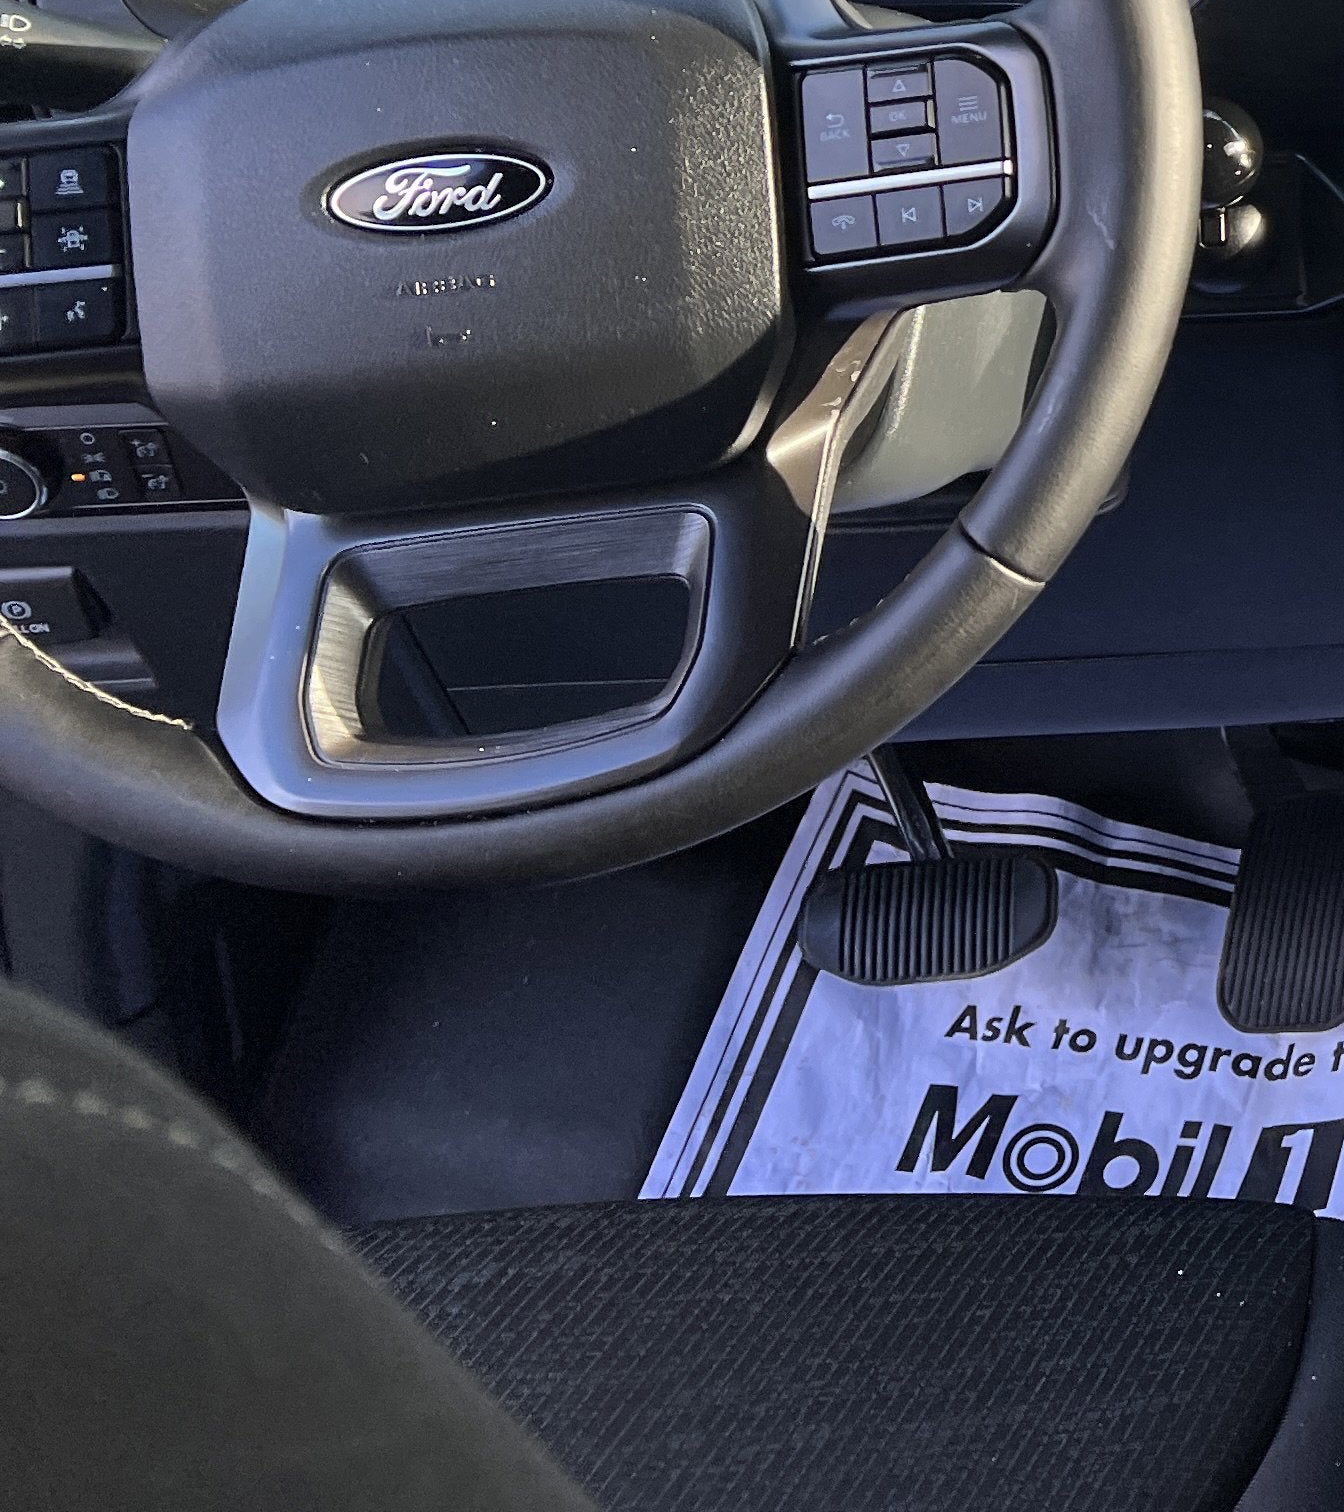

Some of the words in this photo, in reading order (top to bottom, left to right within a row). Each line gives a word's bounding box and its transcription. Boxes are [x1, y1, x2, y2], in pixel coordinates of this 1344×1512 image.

[819, 127, 851, 142] BACK
[951, 111, 988, 124] MENU
[372, 164, 504, 221] Ford
[944, 1004, 1037, 1049] Ask
[1051, 1018, 1097, 1053] to
[1115, 1033, 1317, 1081] upgrade
[895, 1083, 1233, 1199] Mobil
